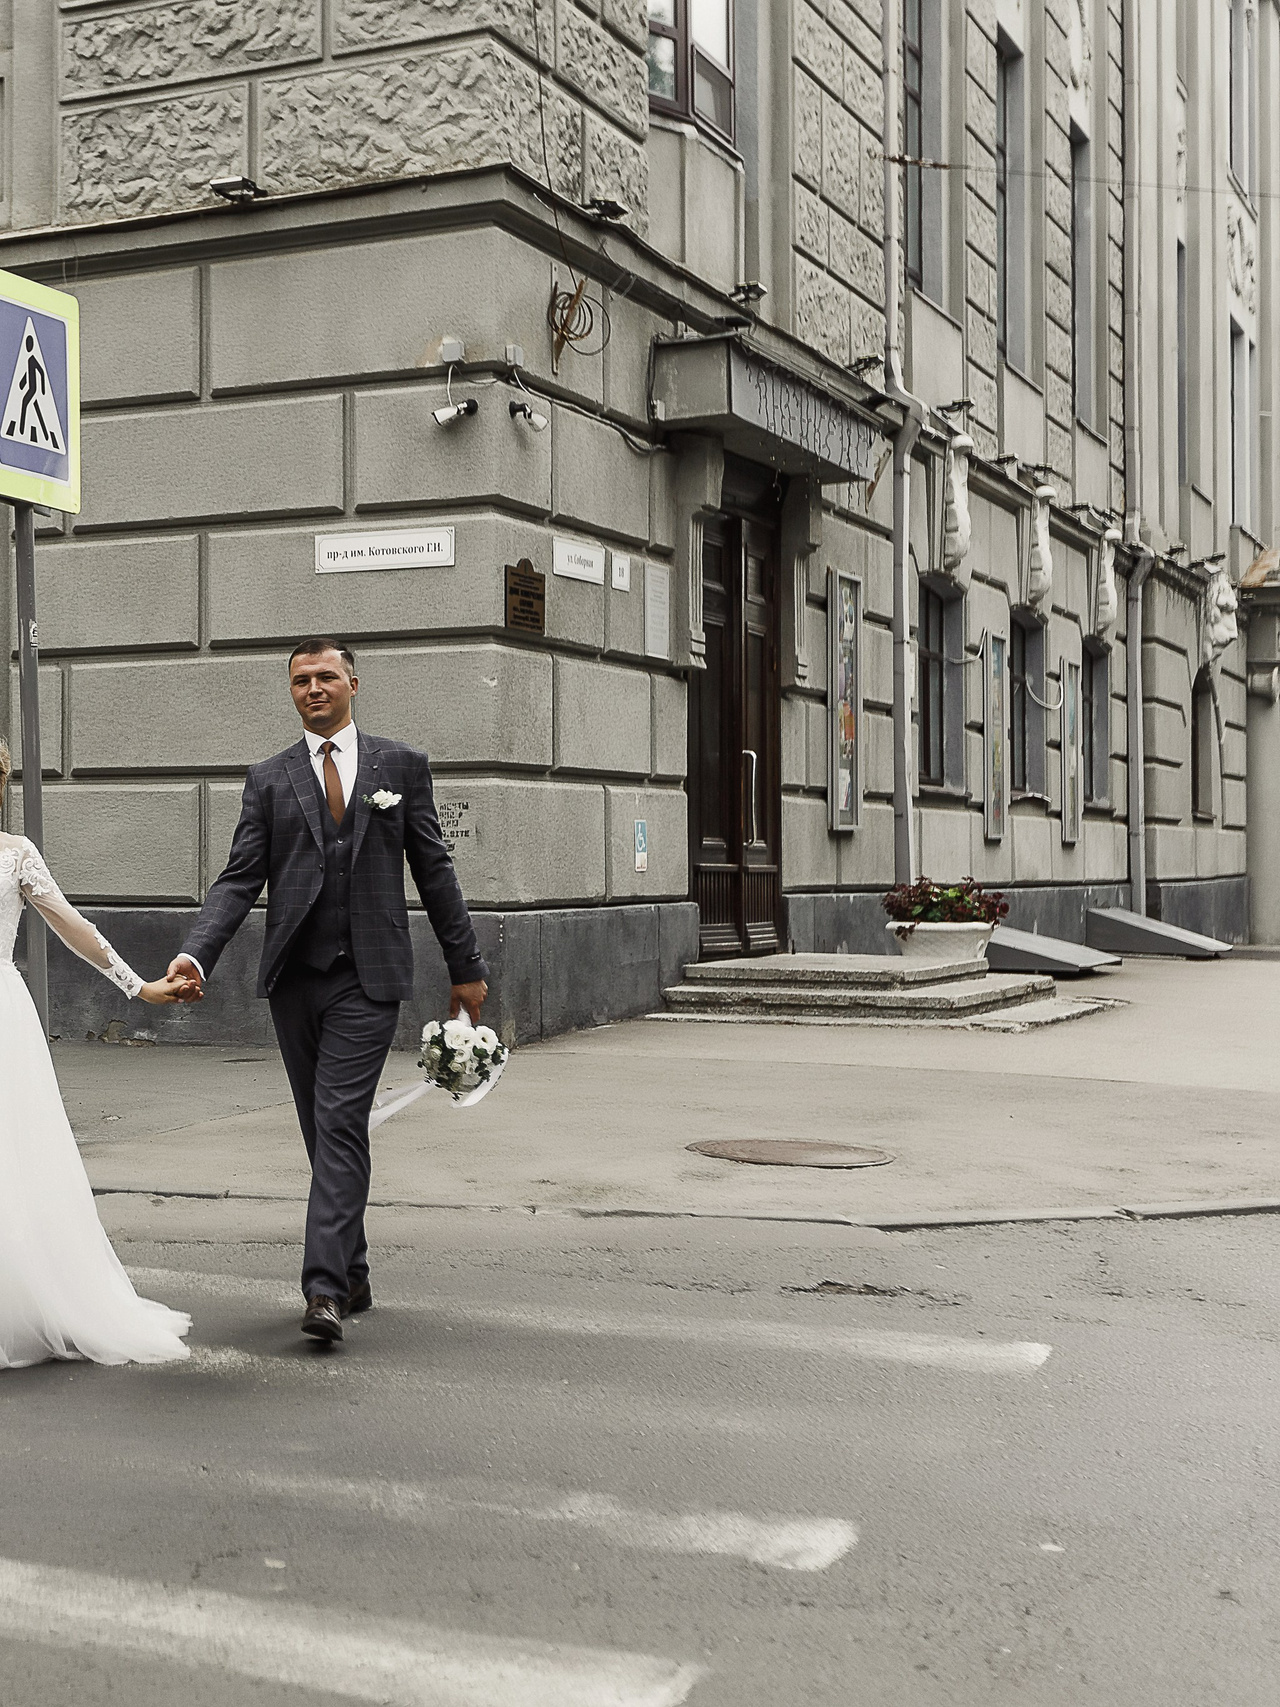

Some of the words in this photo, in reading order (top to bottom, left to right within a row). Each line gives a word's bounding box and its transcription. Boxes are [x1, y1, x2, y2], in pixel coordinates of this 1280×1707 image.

[326, 549, 349, 562] пр-д
[350, 548, 366, 558] им.
[368, 544, 425, 557] Котовского
[427, 541, 444, 553] Г.И.
[574, 553, 594, 570] Соборная
